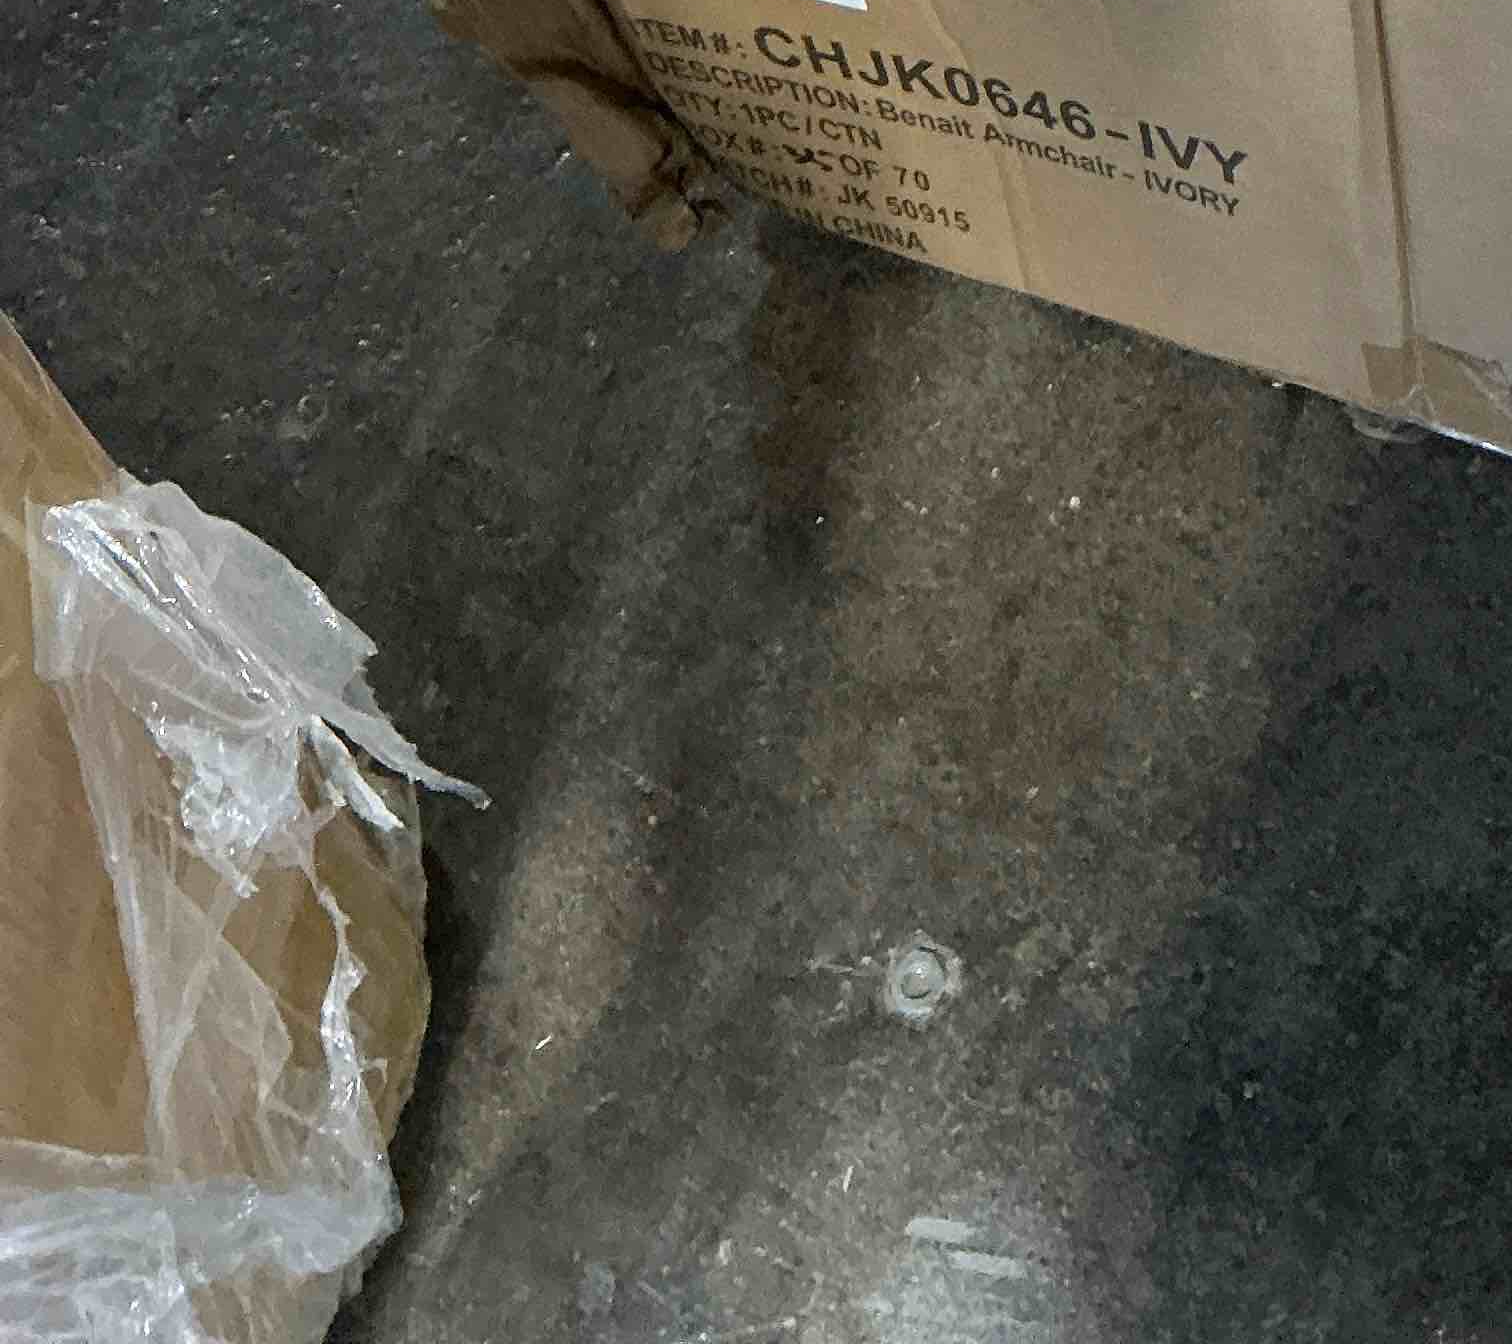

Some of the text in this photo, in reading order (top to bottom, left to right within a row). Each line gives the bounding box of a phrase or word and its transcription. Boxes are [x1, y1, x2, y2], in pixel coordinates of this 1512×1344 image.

[753, 26, 1247, 185] CHJK0646-IVY
[838, 153, 880, 181] OF
[893, 165, 930, 192] 70
[982, 122, 1117, 179] Armchair
[1144, 169, 1240, 216] IVORY
[837, 183, 876, 212] JK
[885, 195, 970, 232] 50915
